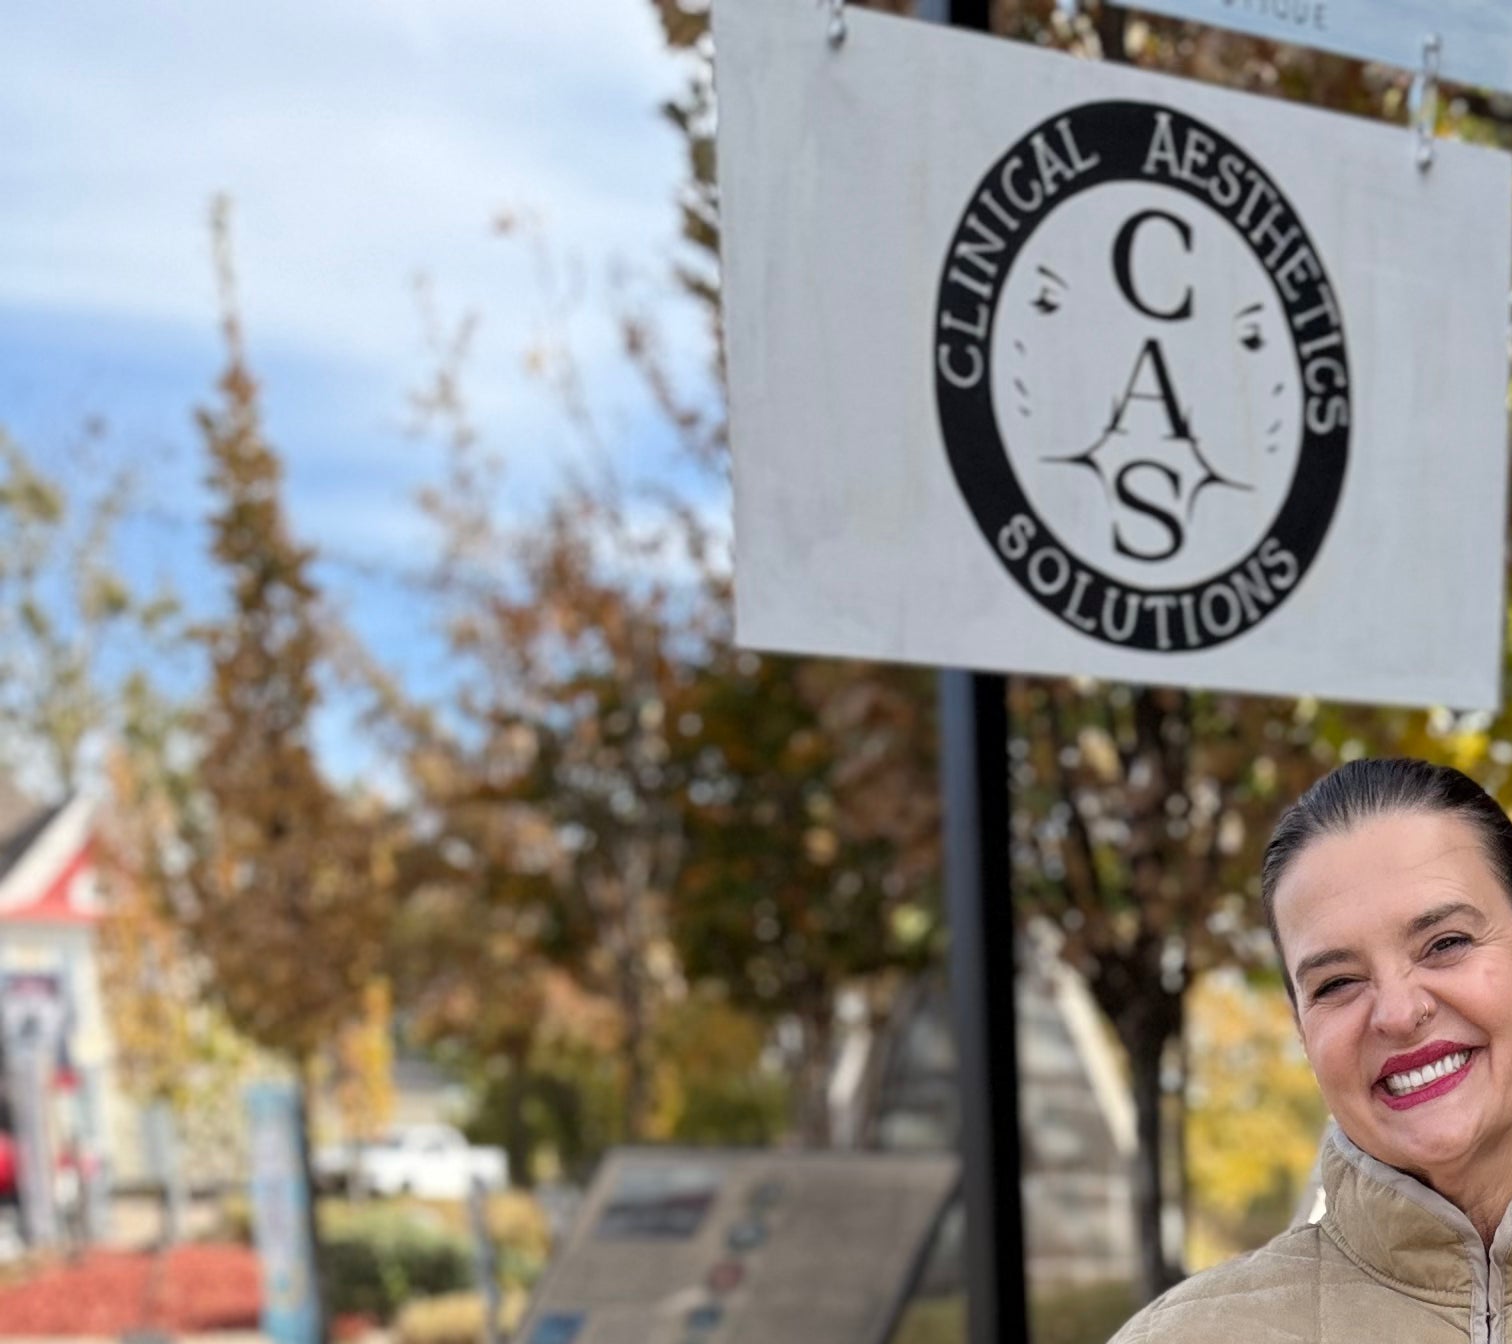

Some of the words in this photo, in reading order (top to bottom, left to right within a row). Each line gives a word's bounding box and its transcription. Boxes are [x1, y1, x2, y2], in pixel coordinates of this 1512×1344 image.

[938, 117, 1101, 388] CLINICAL
[1142, 111, 1348, 434] AESTHETICS
[997, 513, 1299, 650] SOLUTIONS
